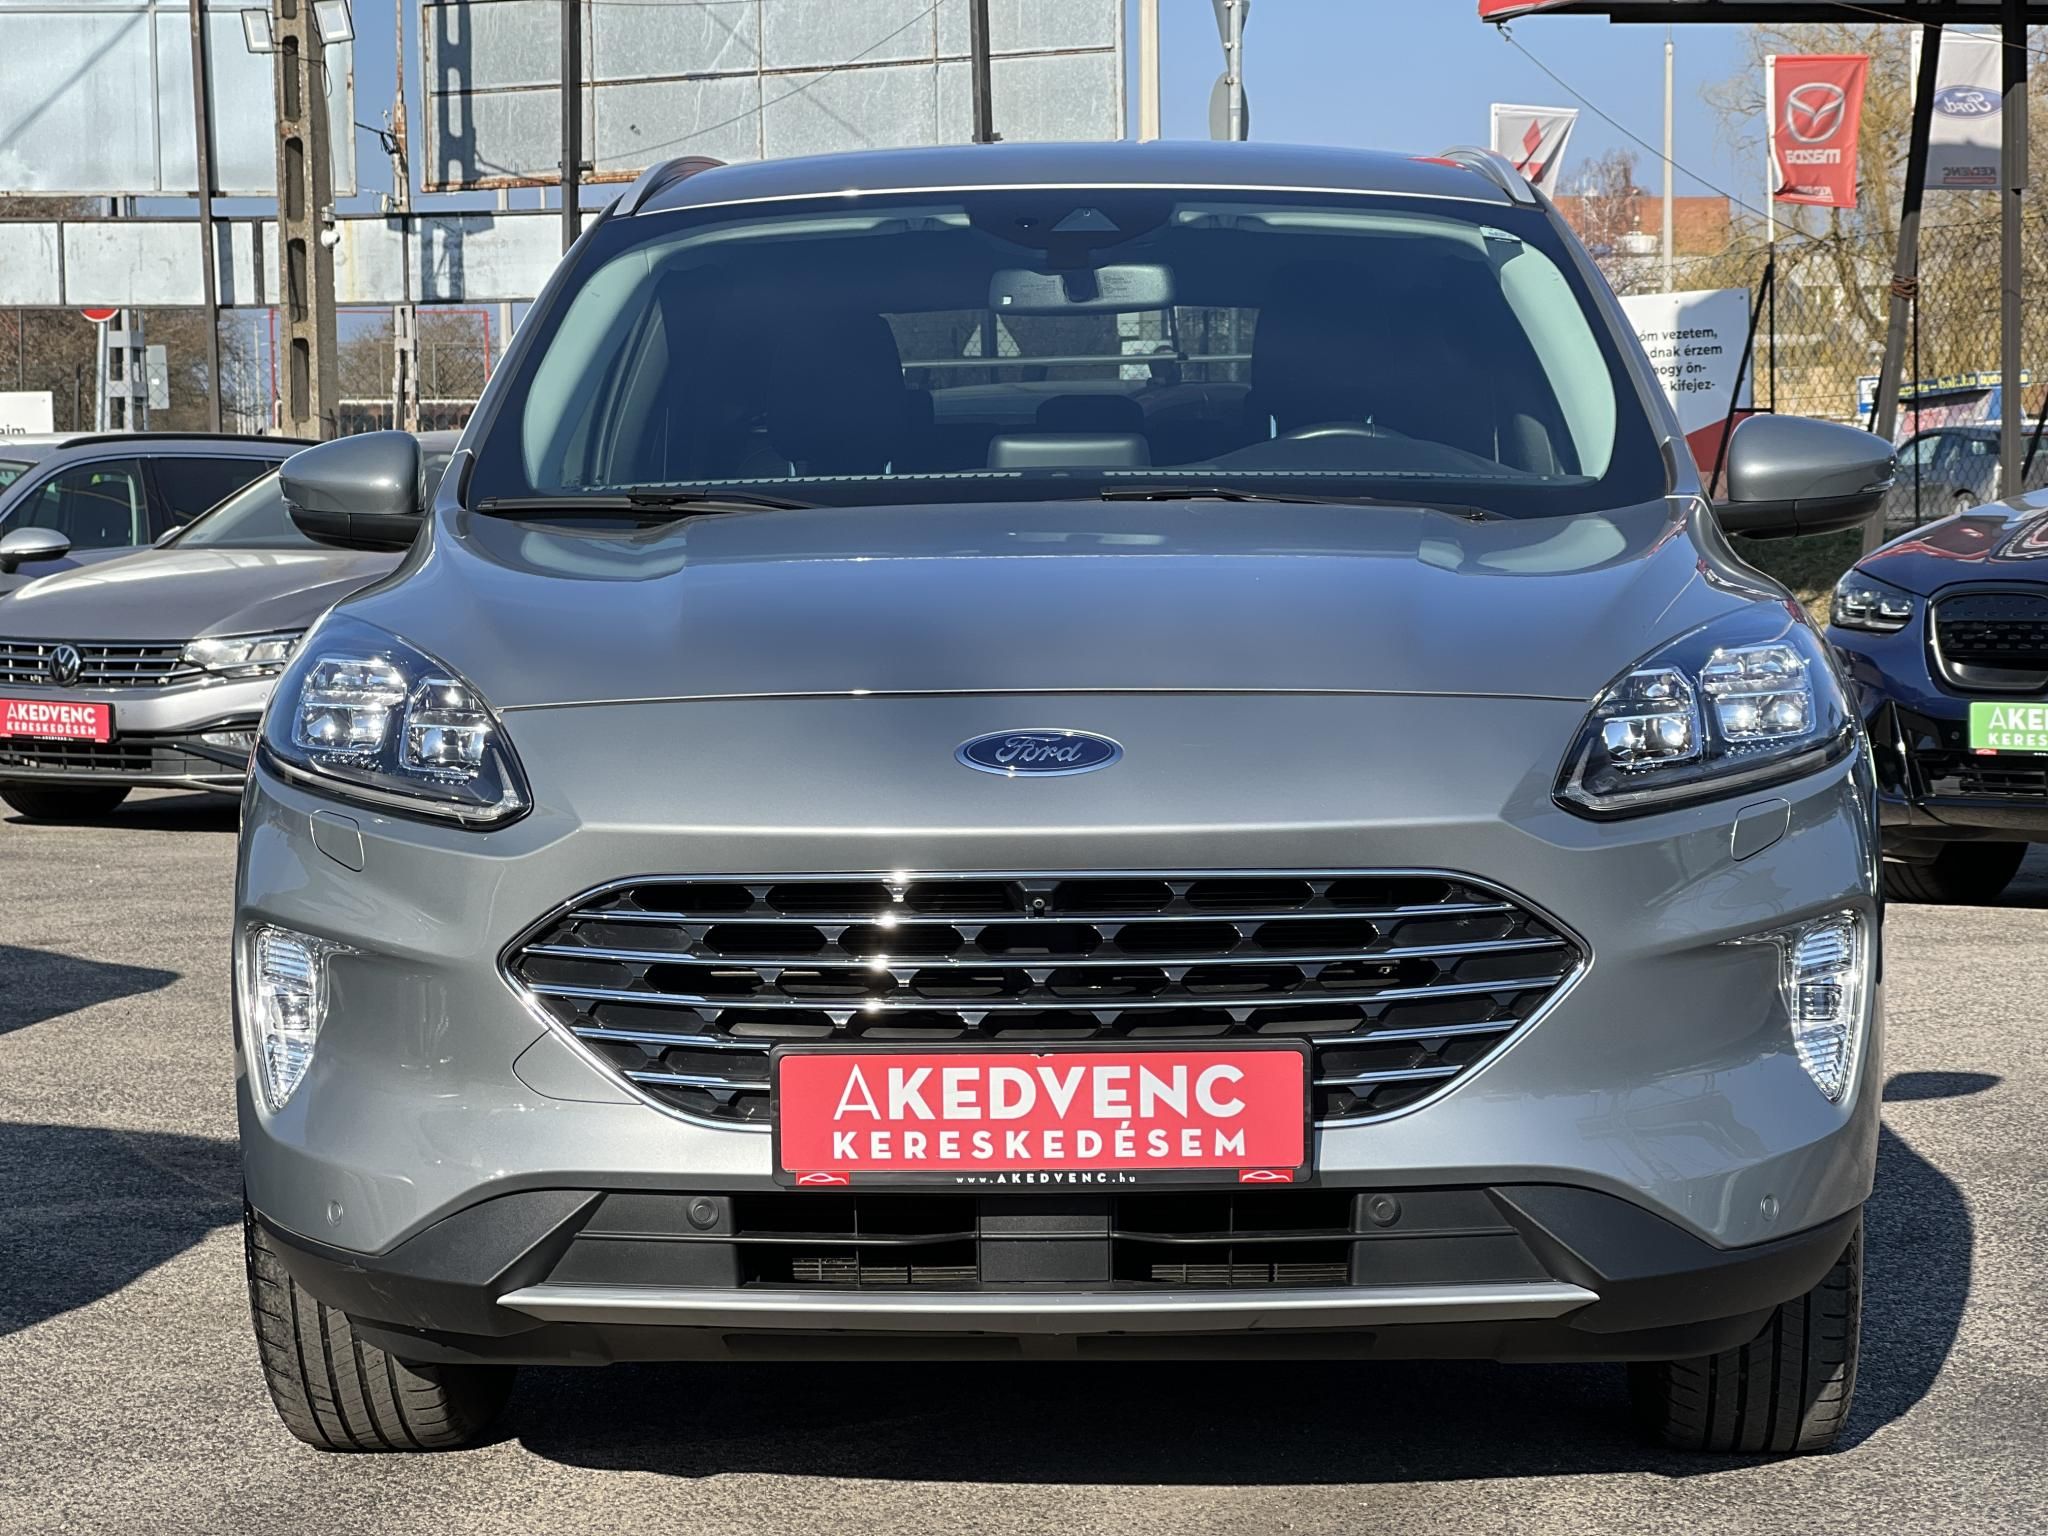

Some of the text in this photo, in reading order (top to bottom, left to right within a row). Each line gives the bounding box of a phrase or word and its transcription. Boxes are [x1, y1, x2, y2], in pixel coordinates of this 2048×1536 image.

[1639, 328, 1718, 341] óm vezetem,
[1649, 344, 1722, 358] dnak érzem
[1670, 378, 1716, 393] kifejez-
[6, 703, 96, 724] AKEDVENC
[1988, 706, 2048, 730] AKE
[6, 721, 96, 736] KERESKEDÉSEM
[1988, 732, 2048, 746] KERES
[995, 736, 1084, 763] Ford
[833, 1063, 1247, 1121] AKEDVENC
[833, 1121, 1247, 1160] KERESKEDÉSEM
[956, 1172, 1138, 1185] www.AKEDVENC.hu
